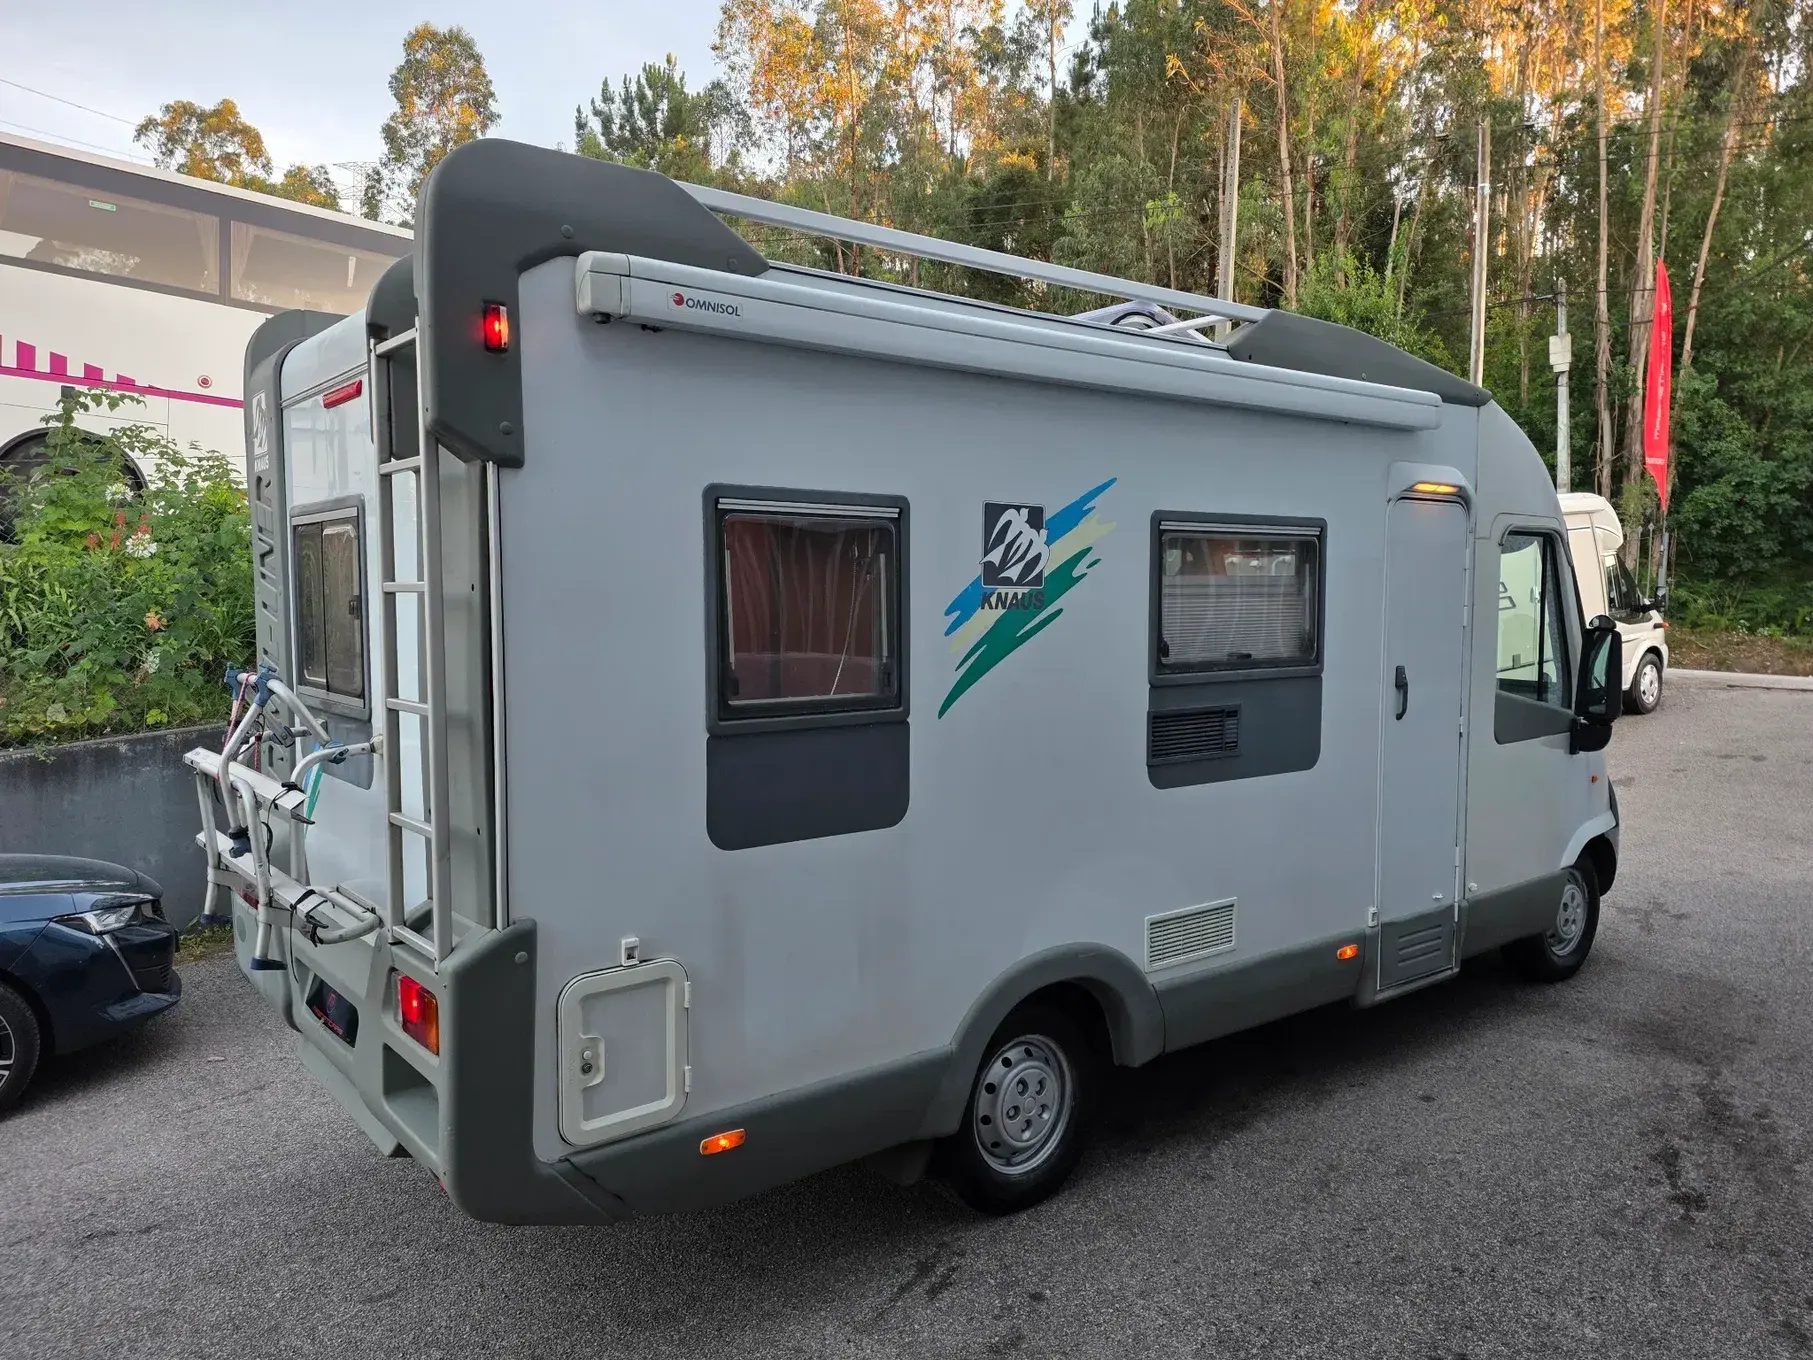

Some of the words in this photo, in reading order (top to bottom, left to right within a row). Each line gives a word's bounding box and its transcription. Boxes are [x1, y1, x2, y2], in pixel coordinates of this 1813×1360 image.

[685, 297, 741, 317] OMNISOL
[254, 454, 270, 473] KNAUS
[980, 591, 1046, 610] KNAUS
